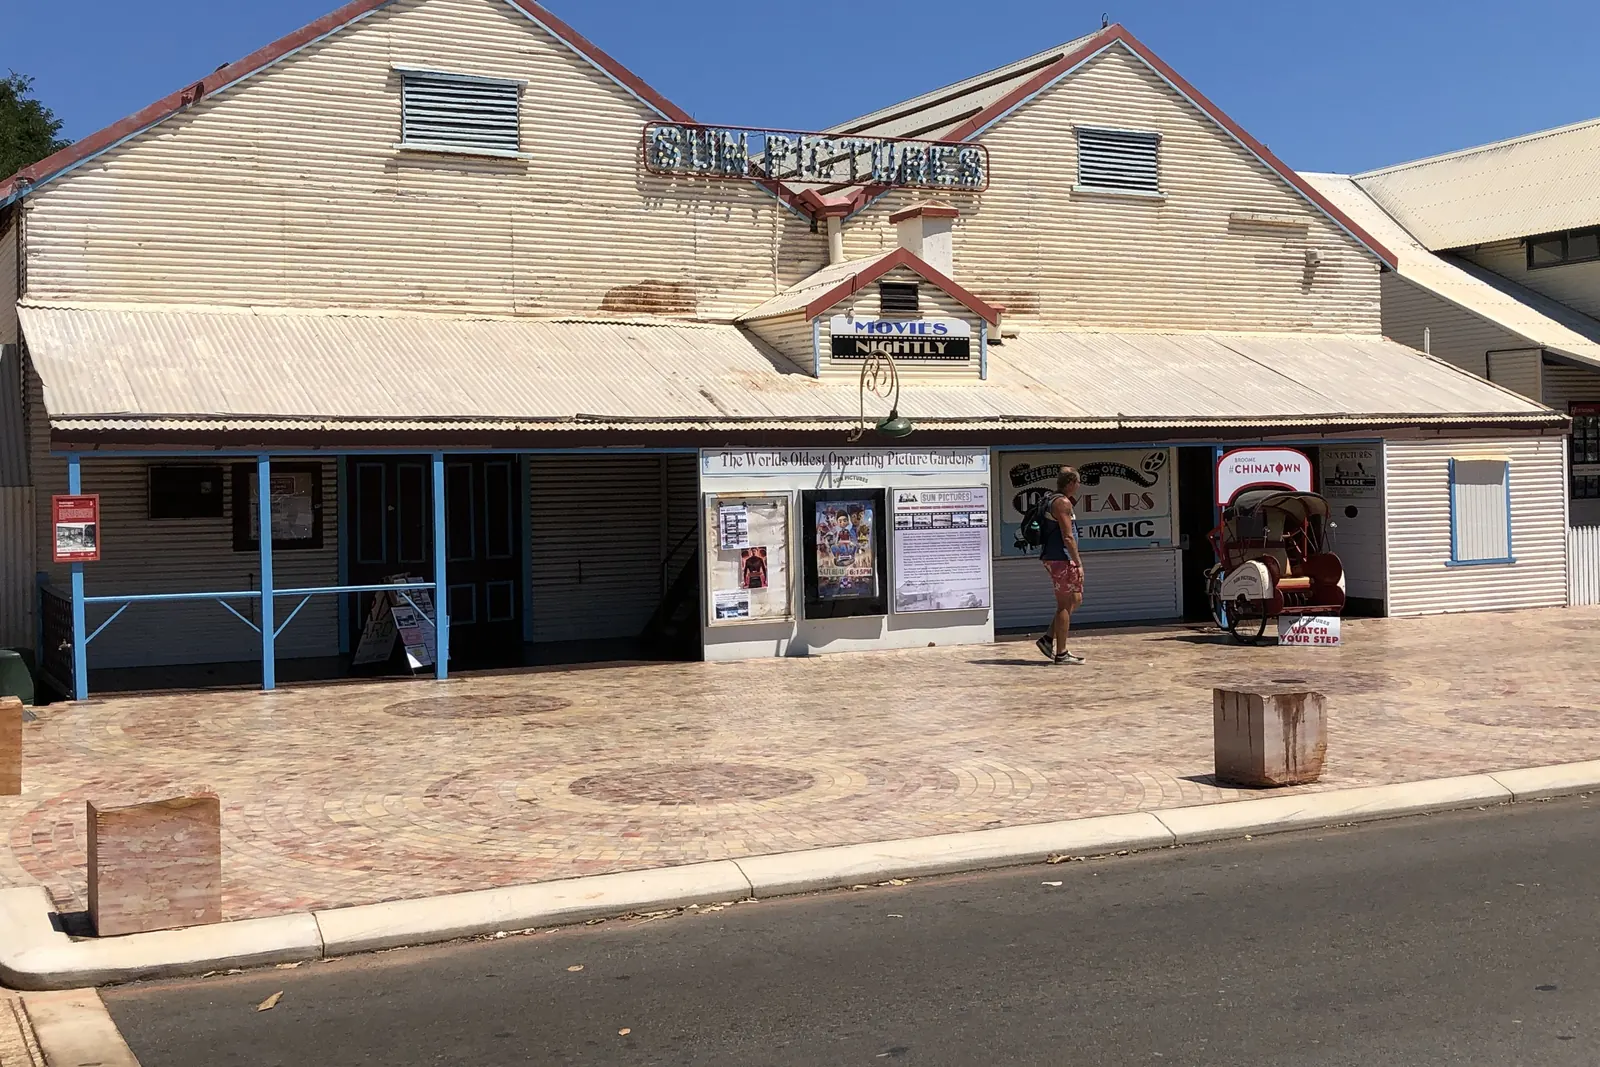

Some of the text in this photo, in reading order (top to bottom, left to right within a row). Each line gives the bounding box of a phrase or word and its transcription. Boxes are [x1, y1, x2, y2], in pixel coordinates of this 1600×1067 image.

[653, 126, 984, 188] SUN PICTURES
[855, 321, 948, 335] MOVIES
[855, 340, 948, 354] NIGHTLY
[720, 450, 974, 469] The Worlds Oldest Operating Picture Gardens
[1101, 465, 1126, 475] OVER
[844, 475, 868, 483] PICTURES
[922, 493, 936, 501] SUN
[939, 492, 970, 501] PICTURES
[1089, 521, 1154, 538] MAGIC
[1291, 627, 1328, 635] WATCH
[1280, 635, 1339, 644] YOUR STEP
